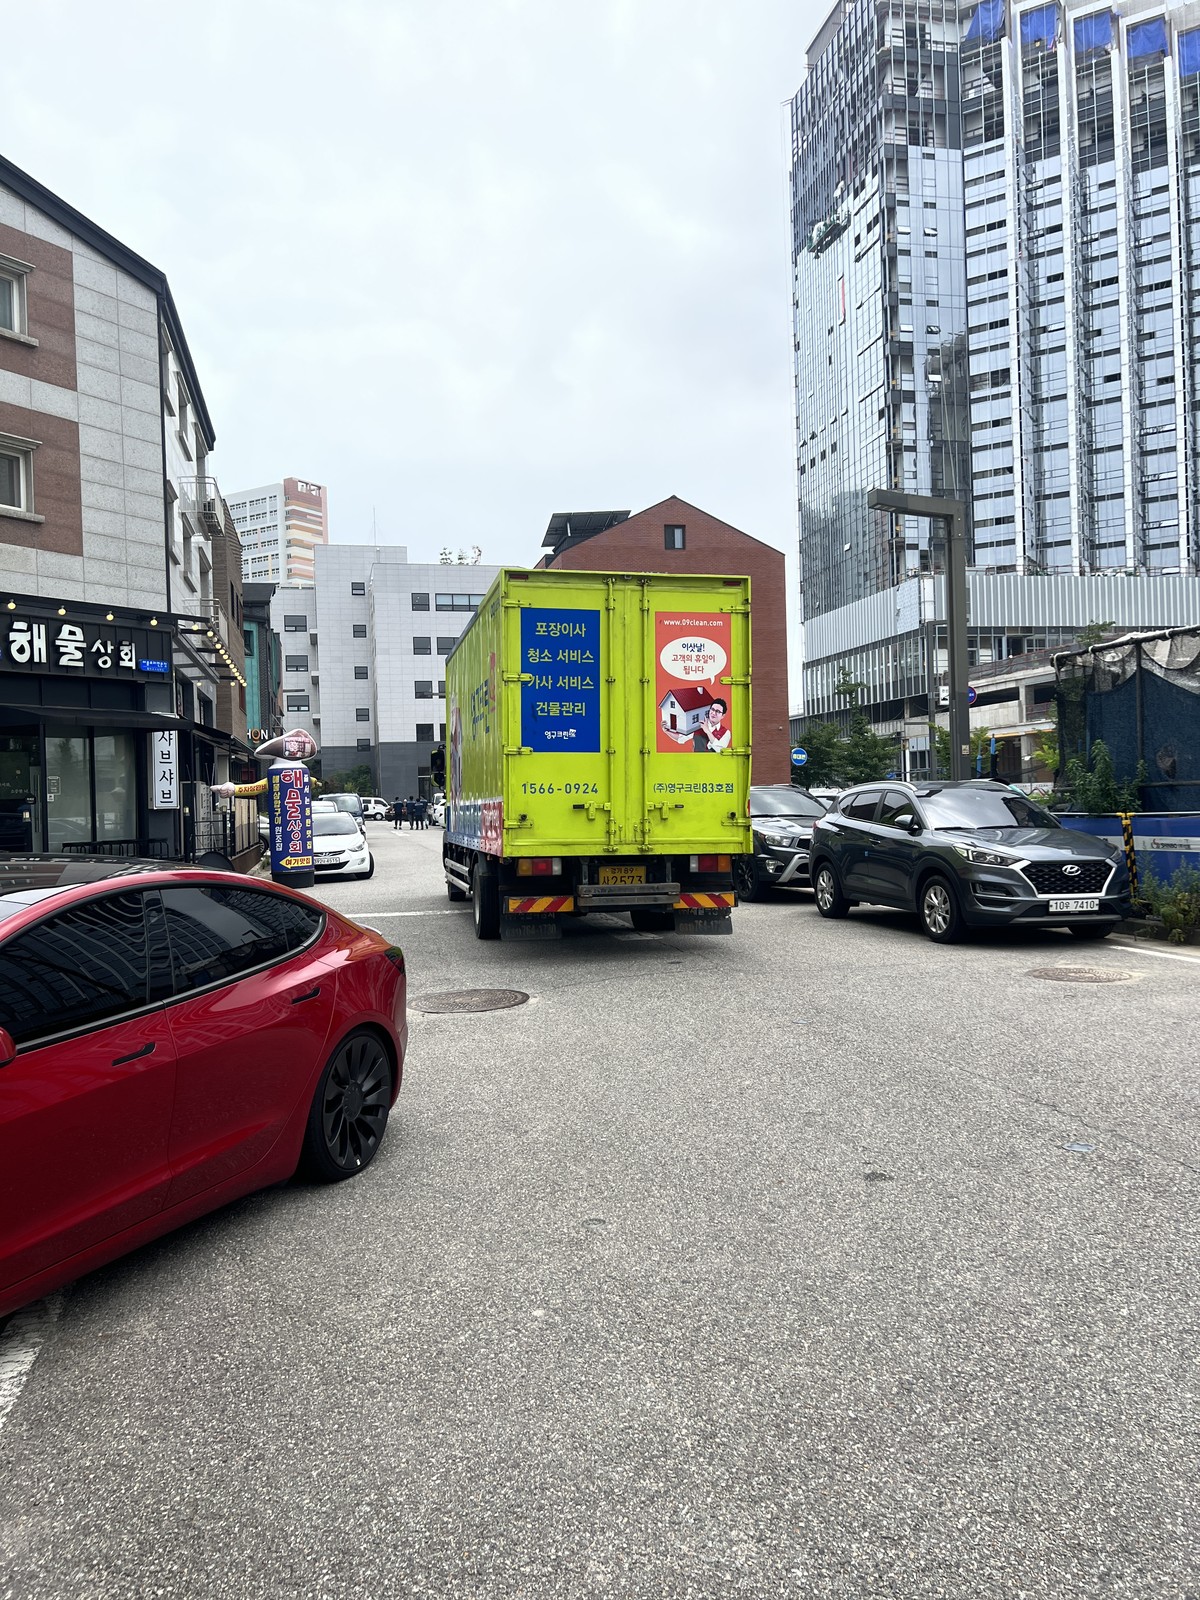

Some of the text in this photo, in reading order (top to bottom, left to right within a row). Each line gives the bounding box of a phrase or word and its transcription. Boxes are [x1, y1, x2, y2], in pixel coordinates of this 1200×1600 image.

[663, 619, 724, 627] www.09clean.com
[535, 622, 587, 638] 포장이사
[8, 621, 137, 670] 해물상회
[681, 643, 706, 653] 이삿날!
[527, 648, 595, 664] 청소 서비스
[672, 654, 716, 664] 고객의 휴일이
[683, 665, 705, 675] 됩니다
[556, 675, 595, 690] 서비스
[536, 701, 586, 717] 건물관리
[544, 730, 569, 740] 영구크린
[158, 730, 174, 804] 샤브샤브
[521, 783, 599, 795] 1566-0924
[652, 782, 735, 794] (주)영구크린83호점
[281, 769, 304, 854] 해물상회
[285, 857, 311, 866] 여기맛집
[1054, 900, 1095, 910] 10우 7410
